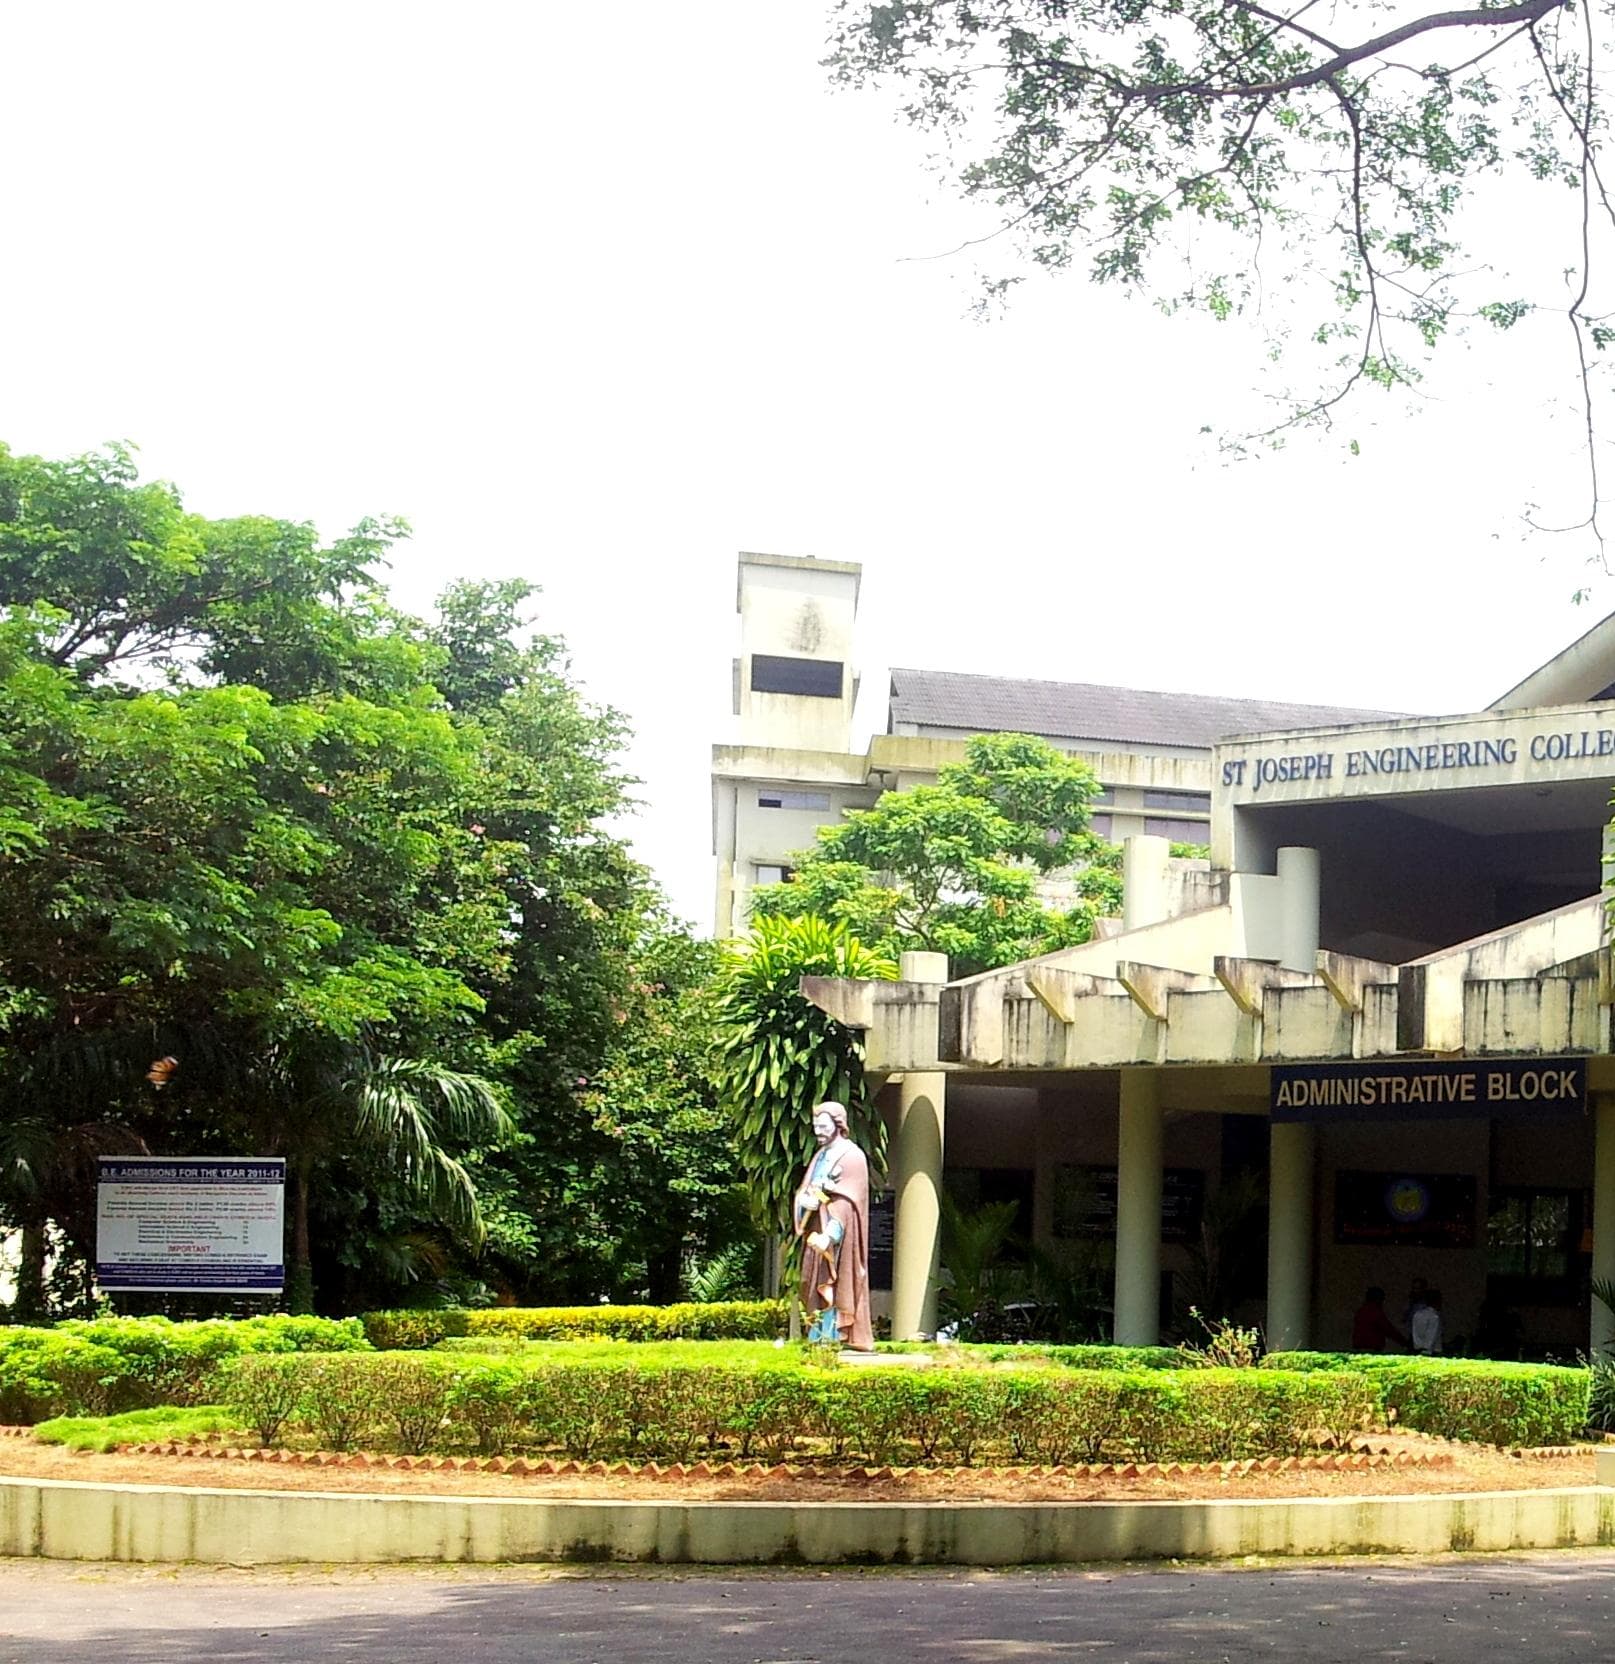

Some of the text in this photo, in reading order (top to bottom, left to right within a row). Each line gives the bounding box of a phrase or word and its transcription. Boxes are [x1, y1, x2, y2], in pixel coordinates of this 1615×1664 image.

[1222, 759, 1247, 787] ST
[1252, 752, 1335, 791] JOSEPH
[1346, 737, 1518, 777] ENGINEERING
[1275, 1070, 1579, 1108] ADMINISTRATIVE BLOCK
[120, 1168, 178, 1178] ADMISSIONS
[179, 1169, 198, 1178] FOR
[201, 1169, 218, 1178] THE
[220, 1169, 246, 1178] YEAR
[247, 1169, 281, 1179] 2011-12
[167, 1245, 211, 1253] IMPORTANT
